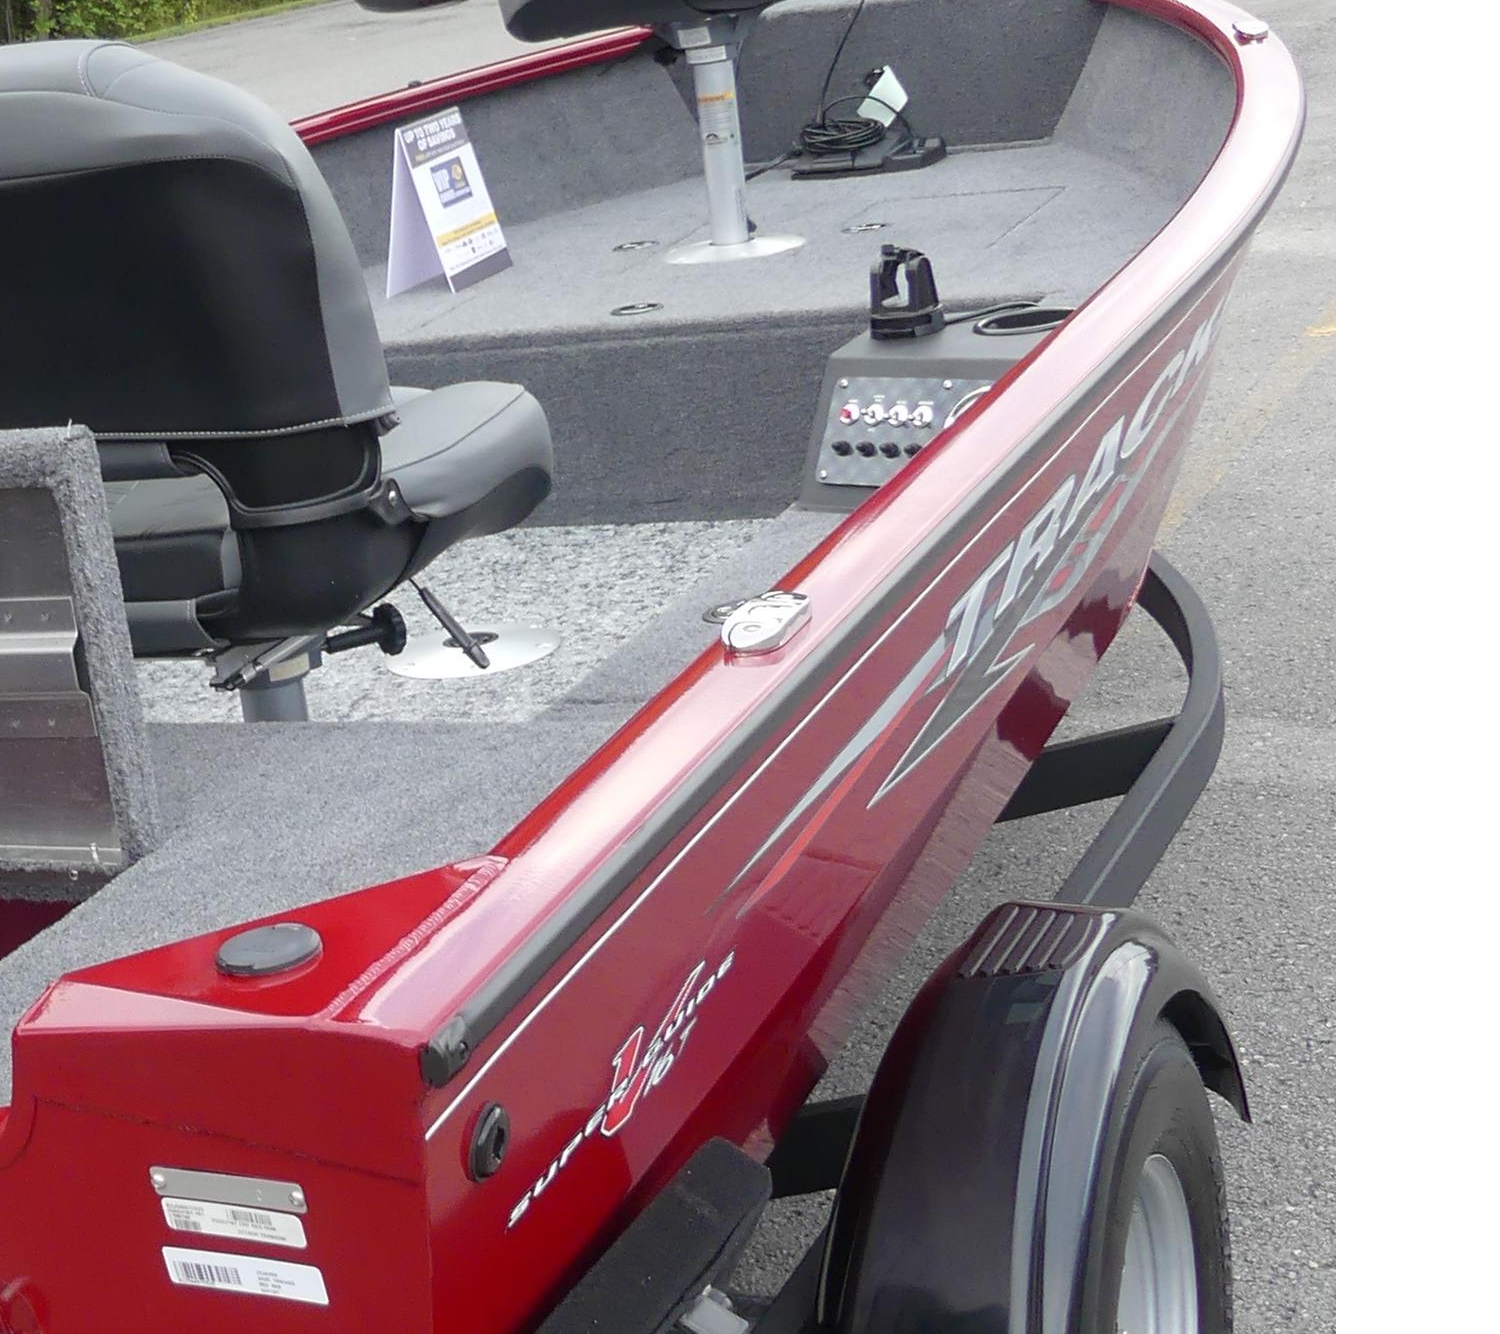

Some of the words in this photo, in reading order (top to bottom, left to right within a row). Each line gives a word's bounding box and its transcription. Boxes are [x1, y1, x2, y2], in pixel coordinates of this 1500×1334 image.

[403, 130, 414, 144] UP
[413, 126, 425, 139] TO
[423, 120, 440, 137] TWO
[439, 112, 461, 130] YEARS
[417, 137, 428, 152] OF
[427, 127, 457, 148] SAVINGS
[505, 1075, 630, 1230] SUPER
[641, 949, 736, 1069] GUIDE
